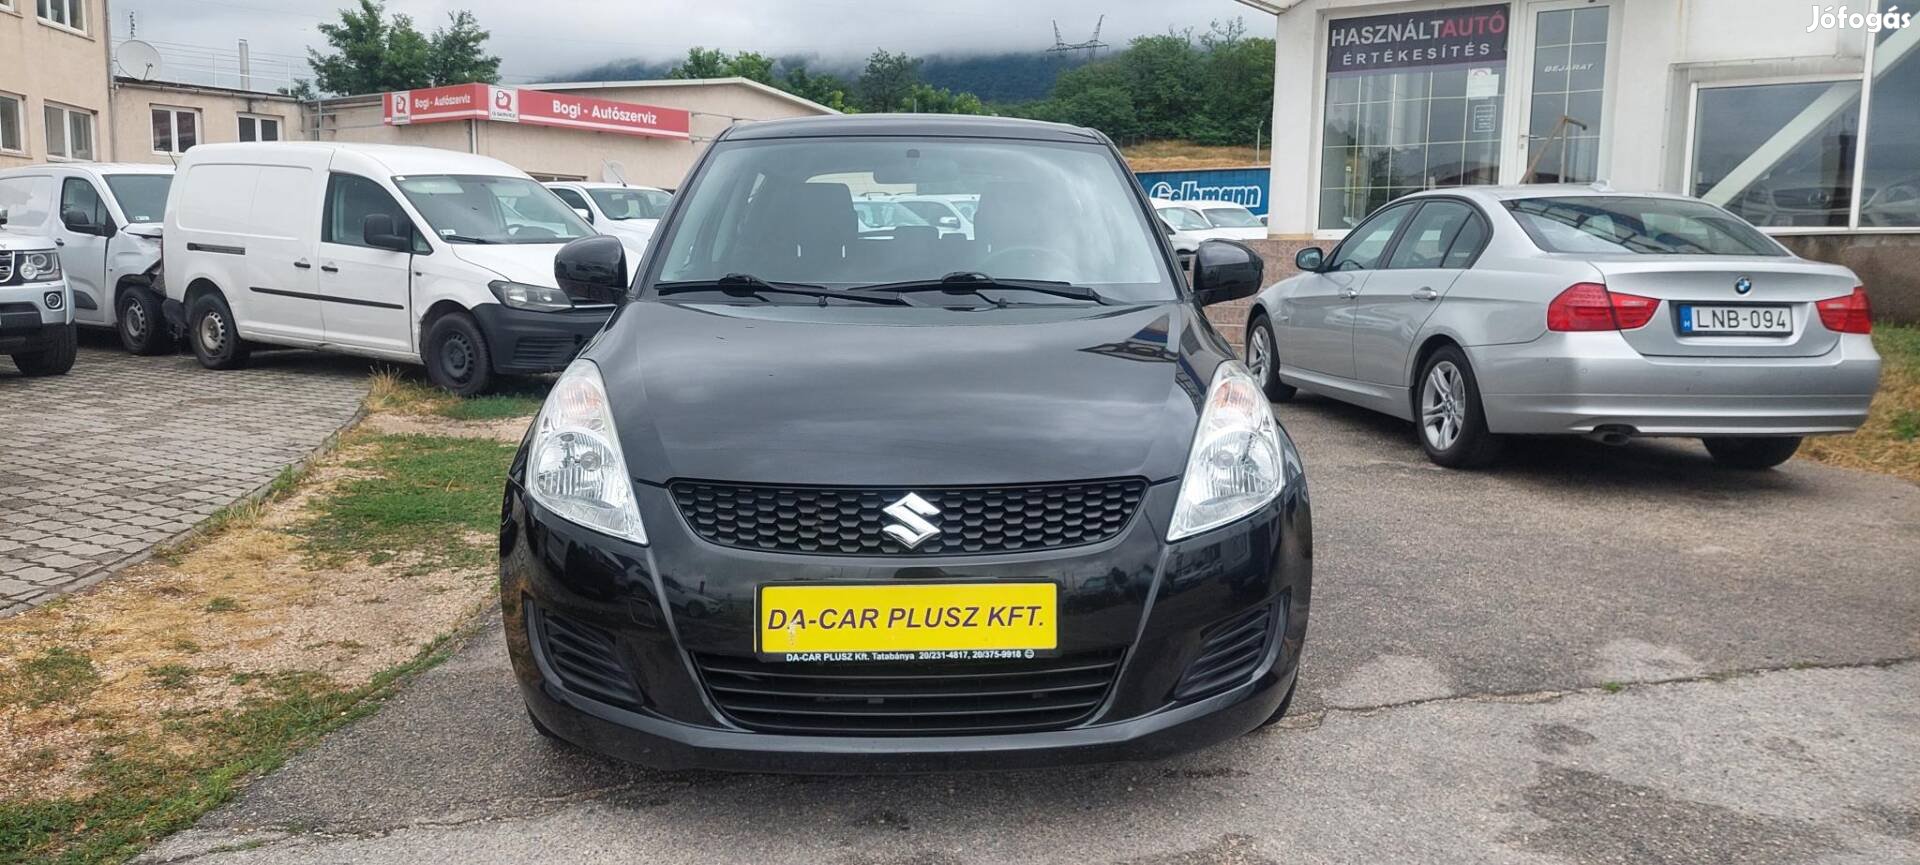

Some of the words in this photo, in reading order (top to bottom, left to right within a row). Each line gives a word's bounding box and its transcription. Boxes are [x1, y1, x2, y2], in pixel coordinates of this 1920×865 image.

[1331, 12, 1506, 47] HASZNÁLTAUTÓ
[1343, 42, 1491, 66] ÉRTÉKESÍTÉS
[414, 97, 430, 110] Bogi
[434, 93, 471, 107] Autószerviz
[552, 100, 581, 119] Bogi
[592, 104, 657, 125] Autószerviz
[1696, 309, 1786, 329] LNB-094
[767, 608, 880, 630] DA-CAR
[887, 607, 979, 629] PLUSZ
[987, 605, 1044, 627] KFT.
[785, 653, 822, 662] DA-CAR
[823, 652, 853, 661] PLUSZ
[854, 652, 870, 661] Kft.
[872, 651, 915, 661] Tatabánya
[919, 650, 972, 660] 20/231-4817,
